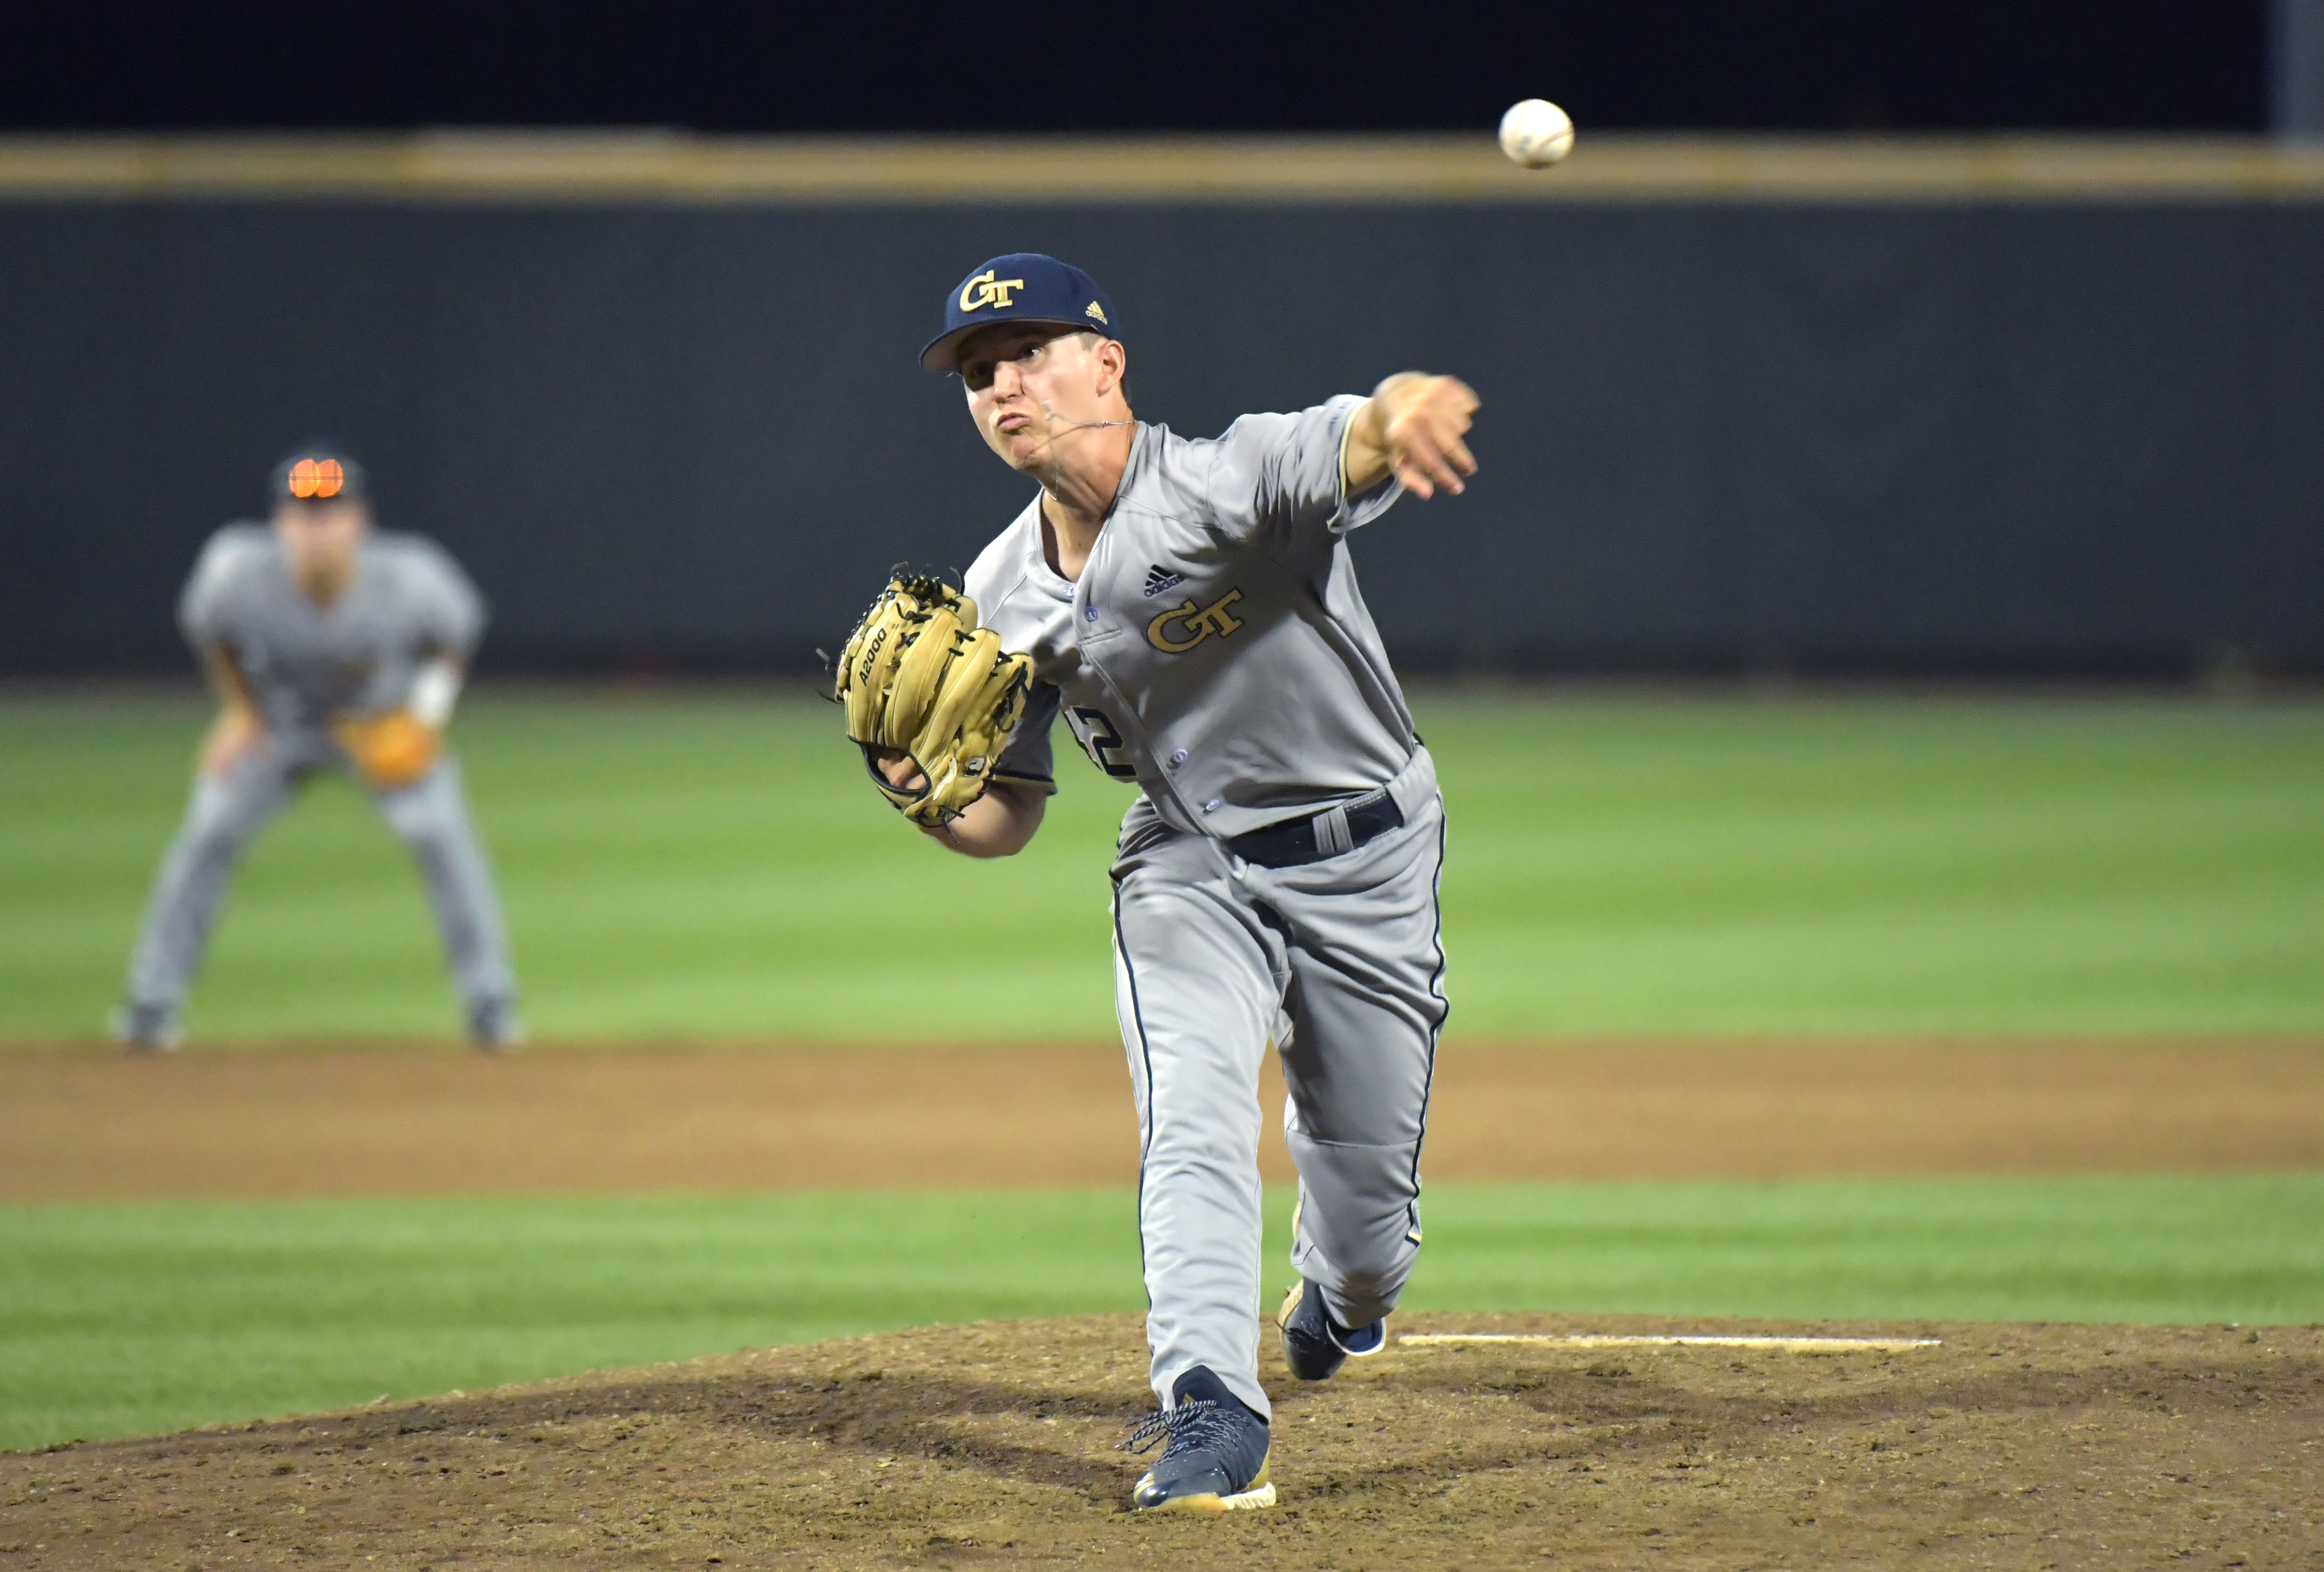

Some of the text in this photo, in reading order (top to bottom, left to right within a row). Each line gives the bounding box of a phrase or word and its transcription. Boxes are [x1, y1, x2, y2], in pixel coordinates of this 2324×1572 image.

[960, 270, 1023, 312] GT
[1147, 587, 1245, 653] GT
[859, 628, 887, 687] A2000
[1062, 706, 1139, 778] 2
